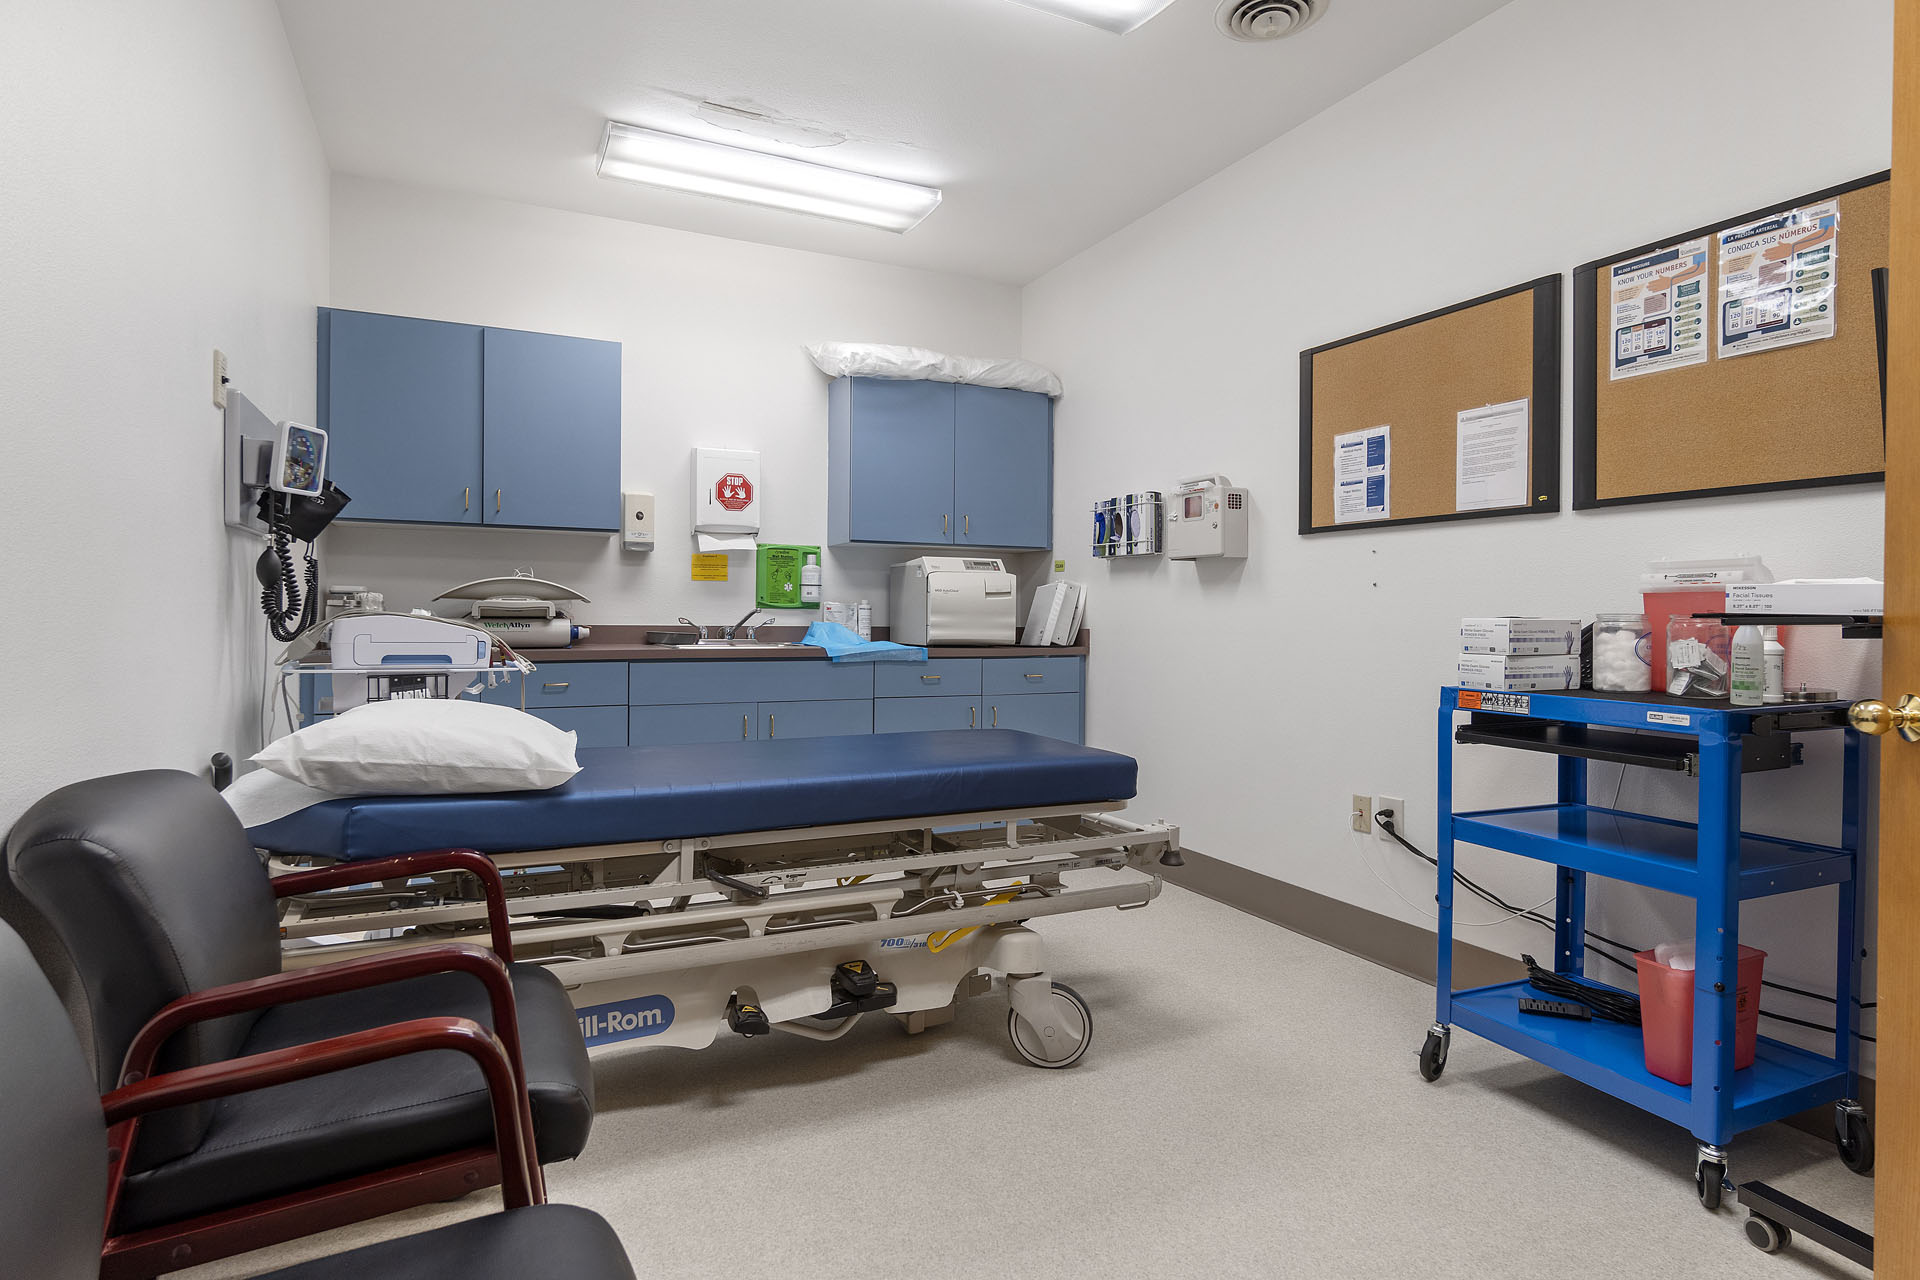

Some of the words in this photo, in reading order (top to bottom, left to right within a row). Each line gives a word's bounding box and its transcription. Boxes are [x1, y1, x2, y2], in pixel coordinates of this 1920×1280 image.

[1727, 240, 1760, 254] CONOZCA
[1762, 236, 1776, 246] SUS
[1778, 223, 1818, 241] NÚMEROS
[1617, 275, 1635, 286] KNOW
[1636, 270, 1653, 280] YOUR
[1655, 261, 1688, 276] NUMBERS
[1730, 312, 1741, 320] 120
[1622, 337, 1631, 345] 120
[726, 476, 743, 486] STOP
[578, 1008, 662, 1038] ill-Rom
